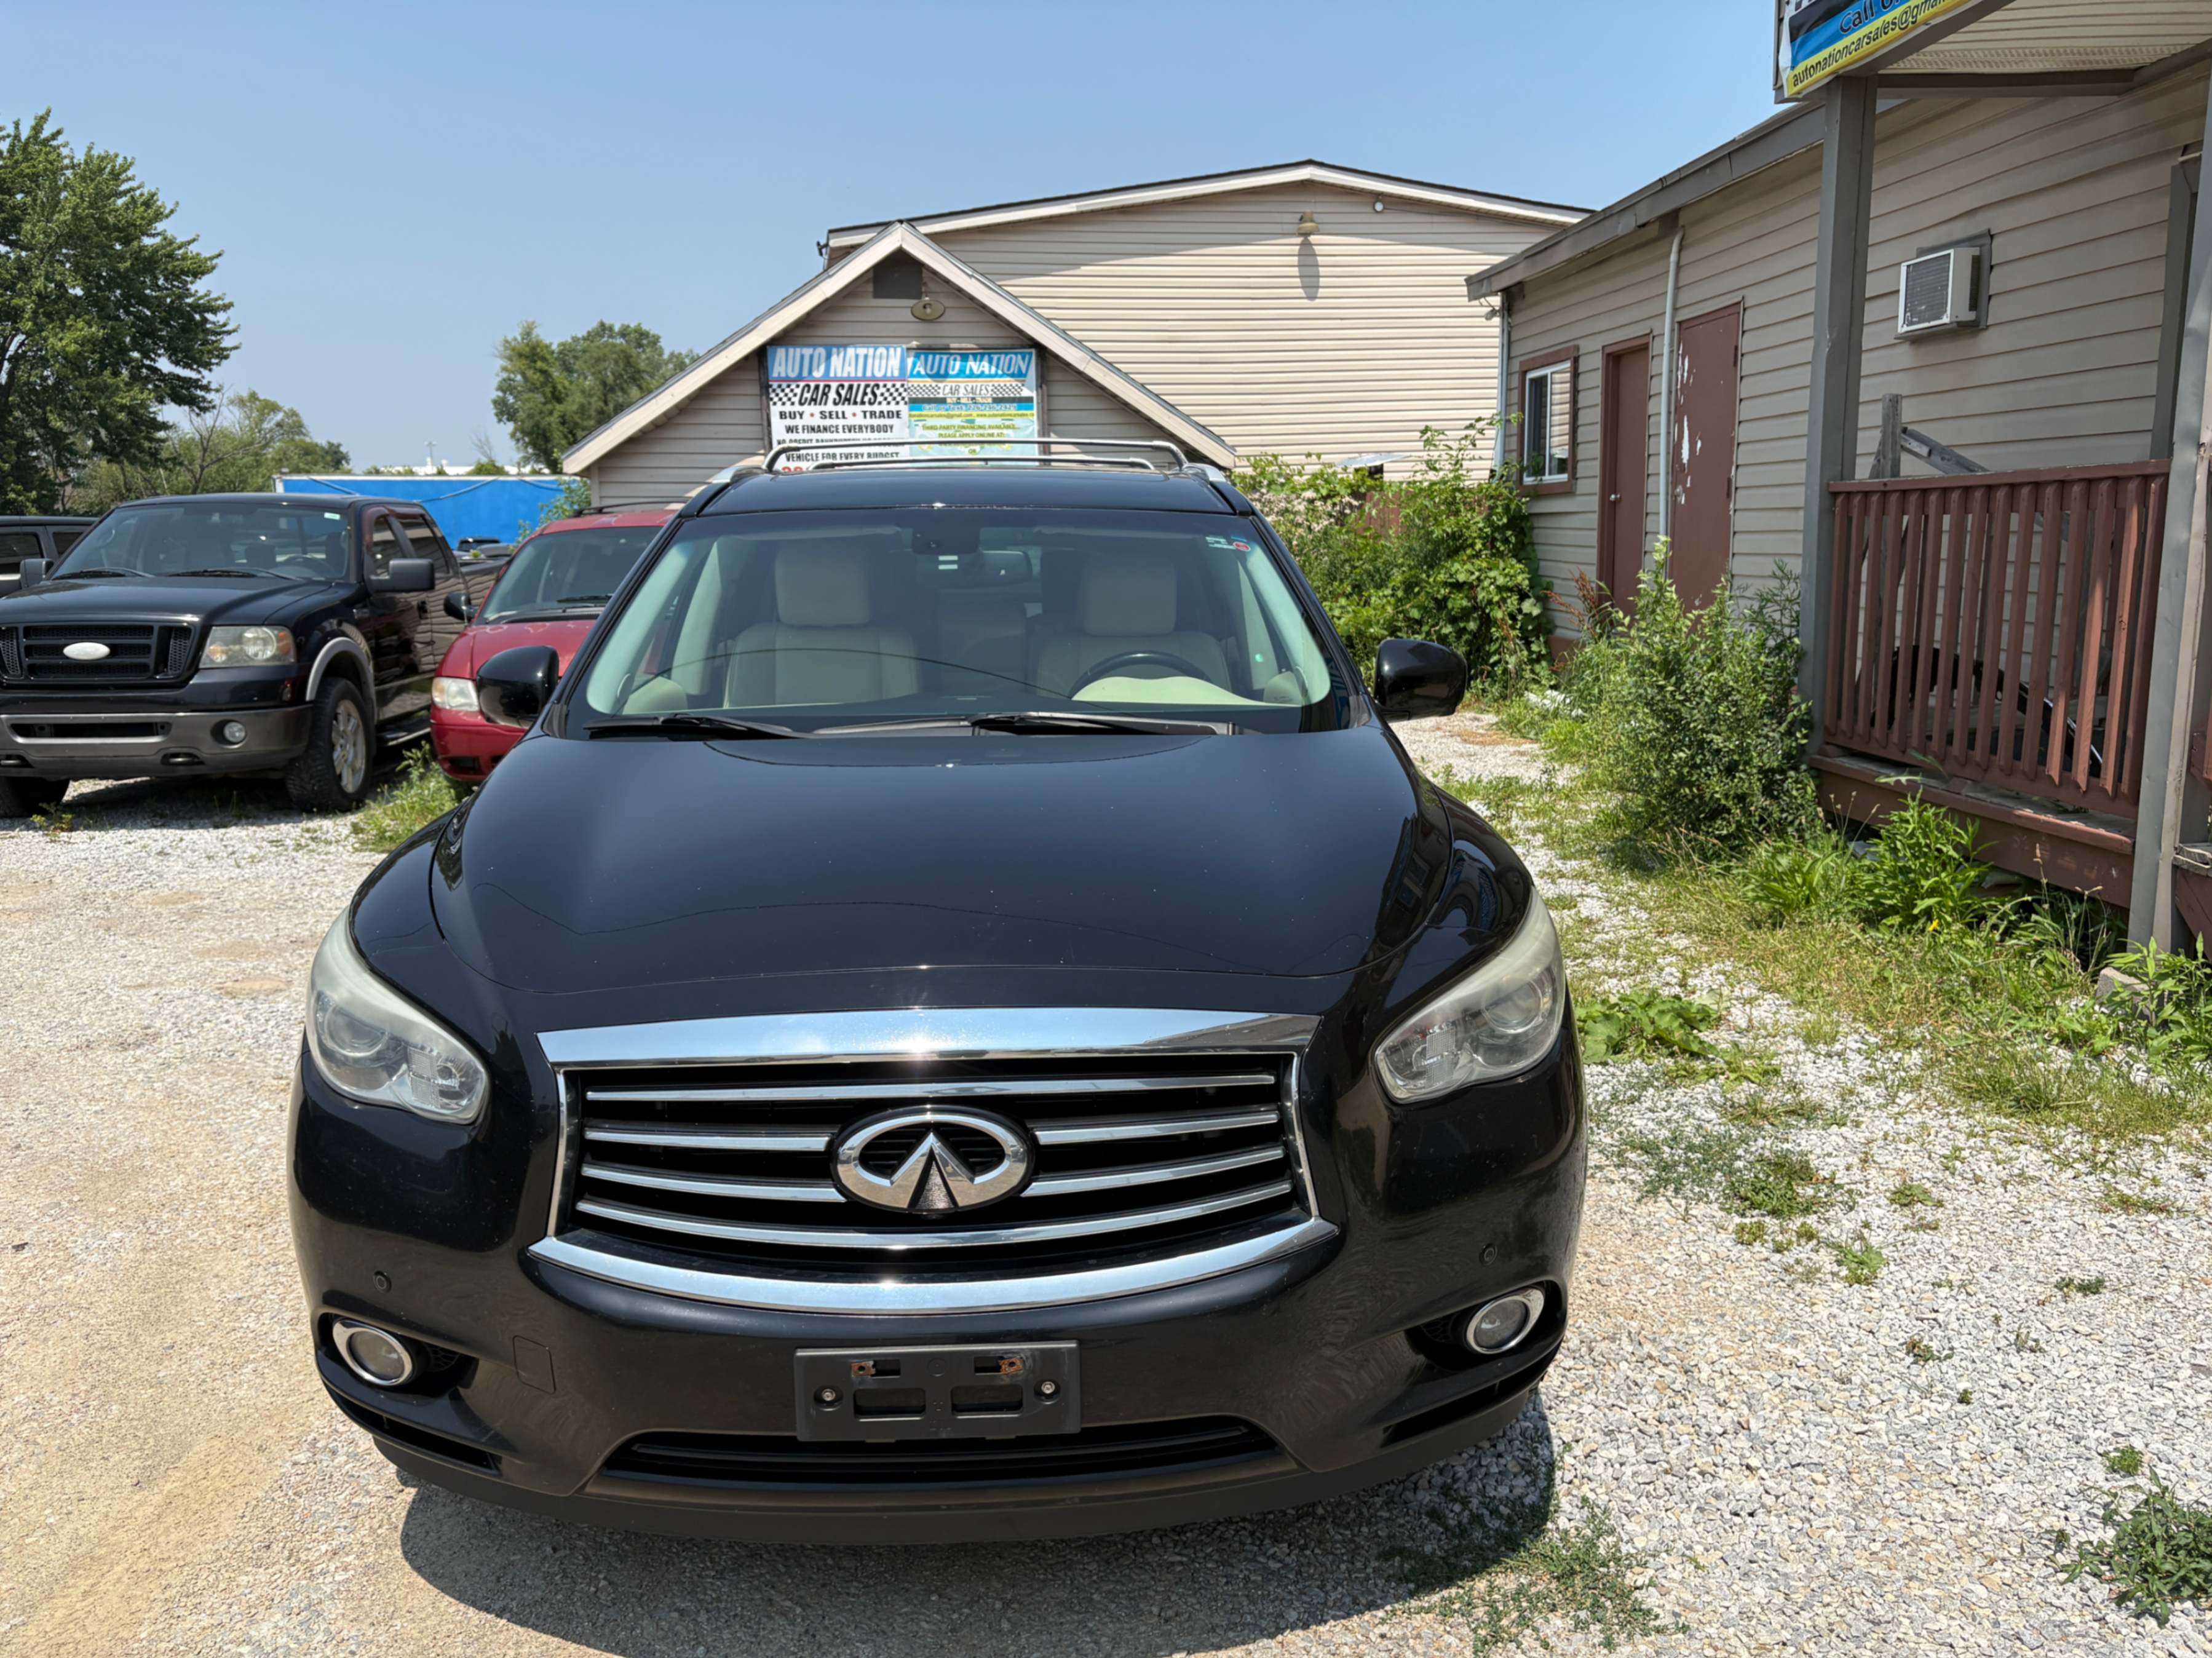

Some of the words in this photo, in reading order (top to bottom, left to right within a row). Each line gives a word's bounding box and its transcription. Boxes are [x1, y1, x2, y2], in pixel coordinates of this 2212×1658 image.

[1839, 0, 1874, 33] Call
[1881, 0, 1900, 10] o
[1792, 0, 1946, 87] autonationcarsales@gma
[772, 347, 827, 378] AUTO
[829, 347, 902, 378] NATION
[913, 354, 961, 375] AUTO
[965, 354, 1029, 375] NATION
[799, 383, 831, 406] CAR
[832, 383, 880, 406] SALES
[942, 384, 960, 396] CAR
[963, 384, 991, 396] SALES
[779, 410, 805, 419] BUY
[819, 410, 848, 419] SELL
[861, 410, 902, 419] TRADE
[785, 424, 799, 434] WE
[802, 424, 839, 434] FINANCE
[842, 424, 894, 434] EVERYBODY
[785, 453, 820, 462] VEHICLE
[839, 452, 864, 461] EVERY
